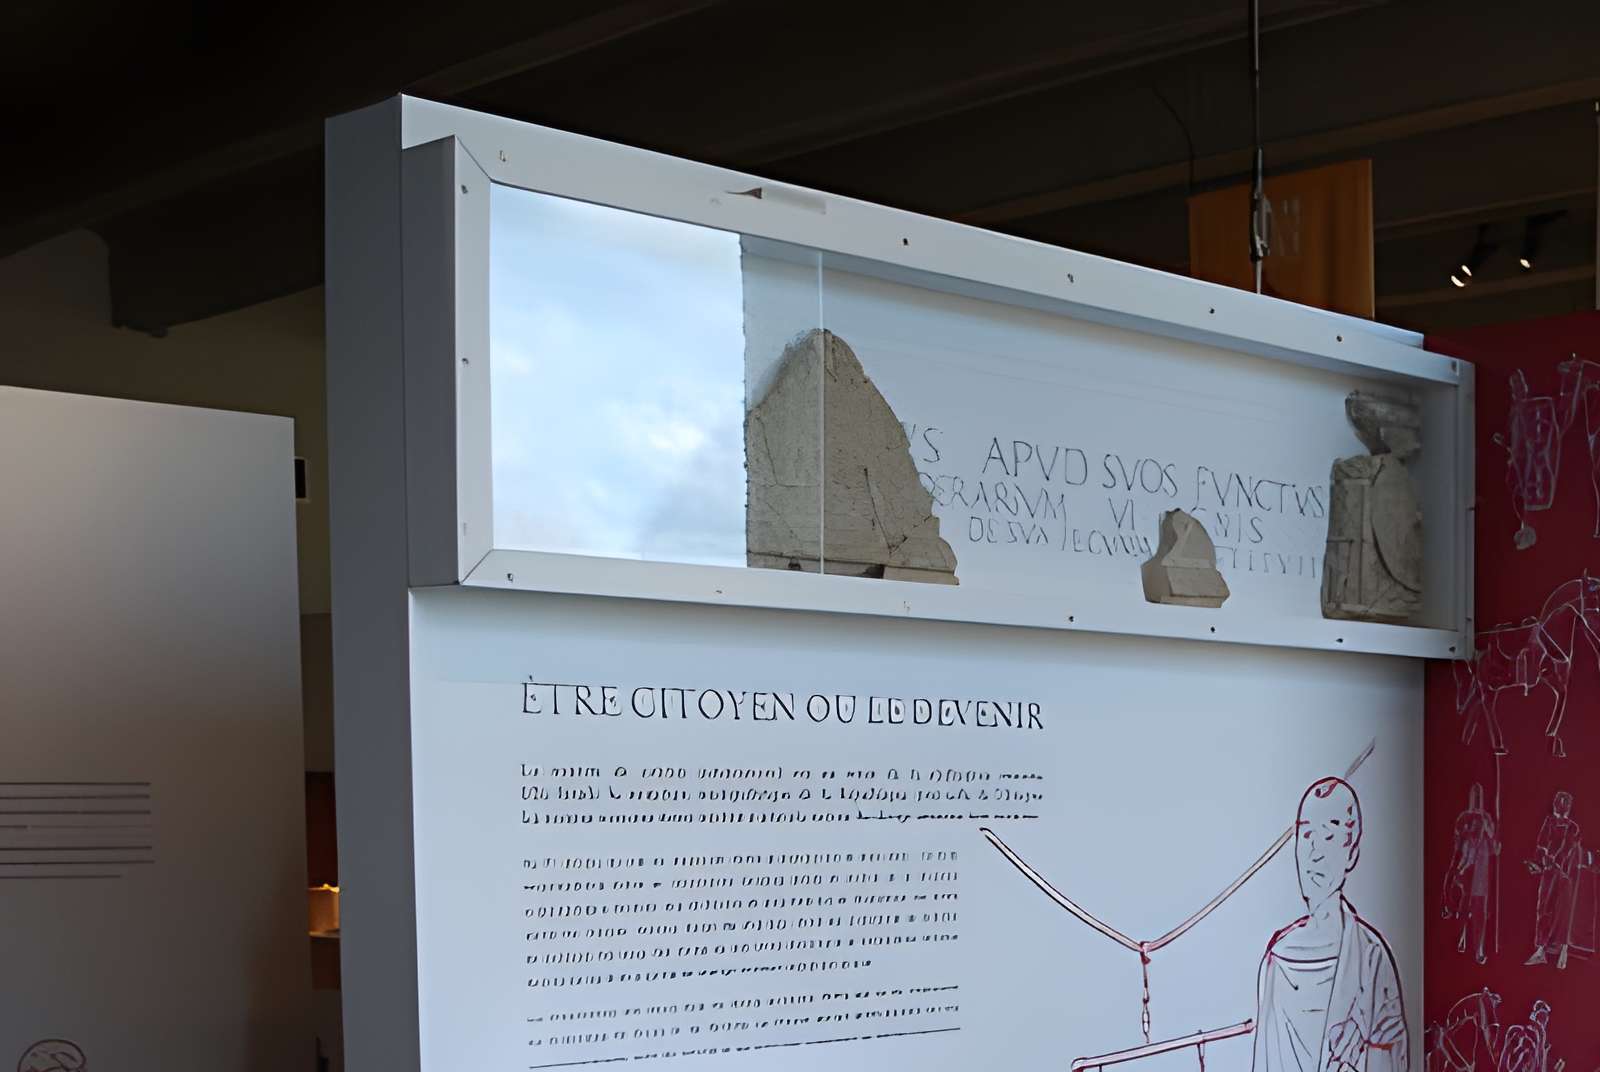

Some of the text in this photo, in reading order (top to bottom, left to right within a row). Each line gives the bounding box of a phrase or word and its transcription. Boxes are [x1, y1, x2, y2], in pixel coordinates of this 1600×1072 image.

[1102, 454, 1179, 498] SVOS
[631, 686, 796, 721] CITOYEN
[806, 694, 856, 724] OU
[913, 698, 1044, 730] DEVENIR
